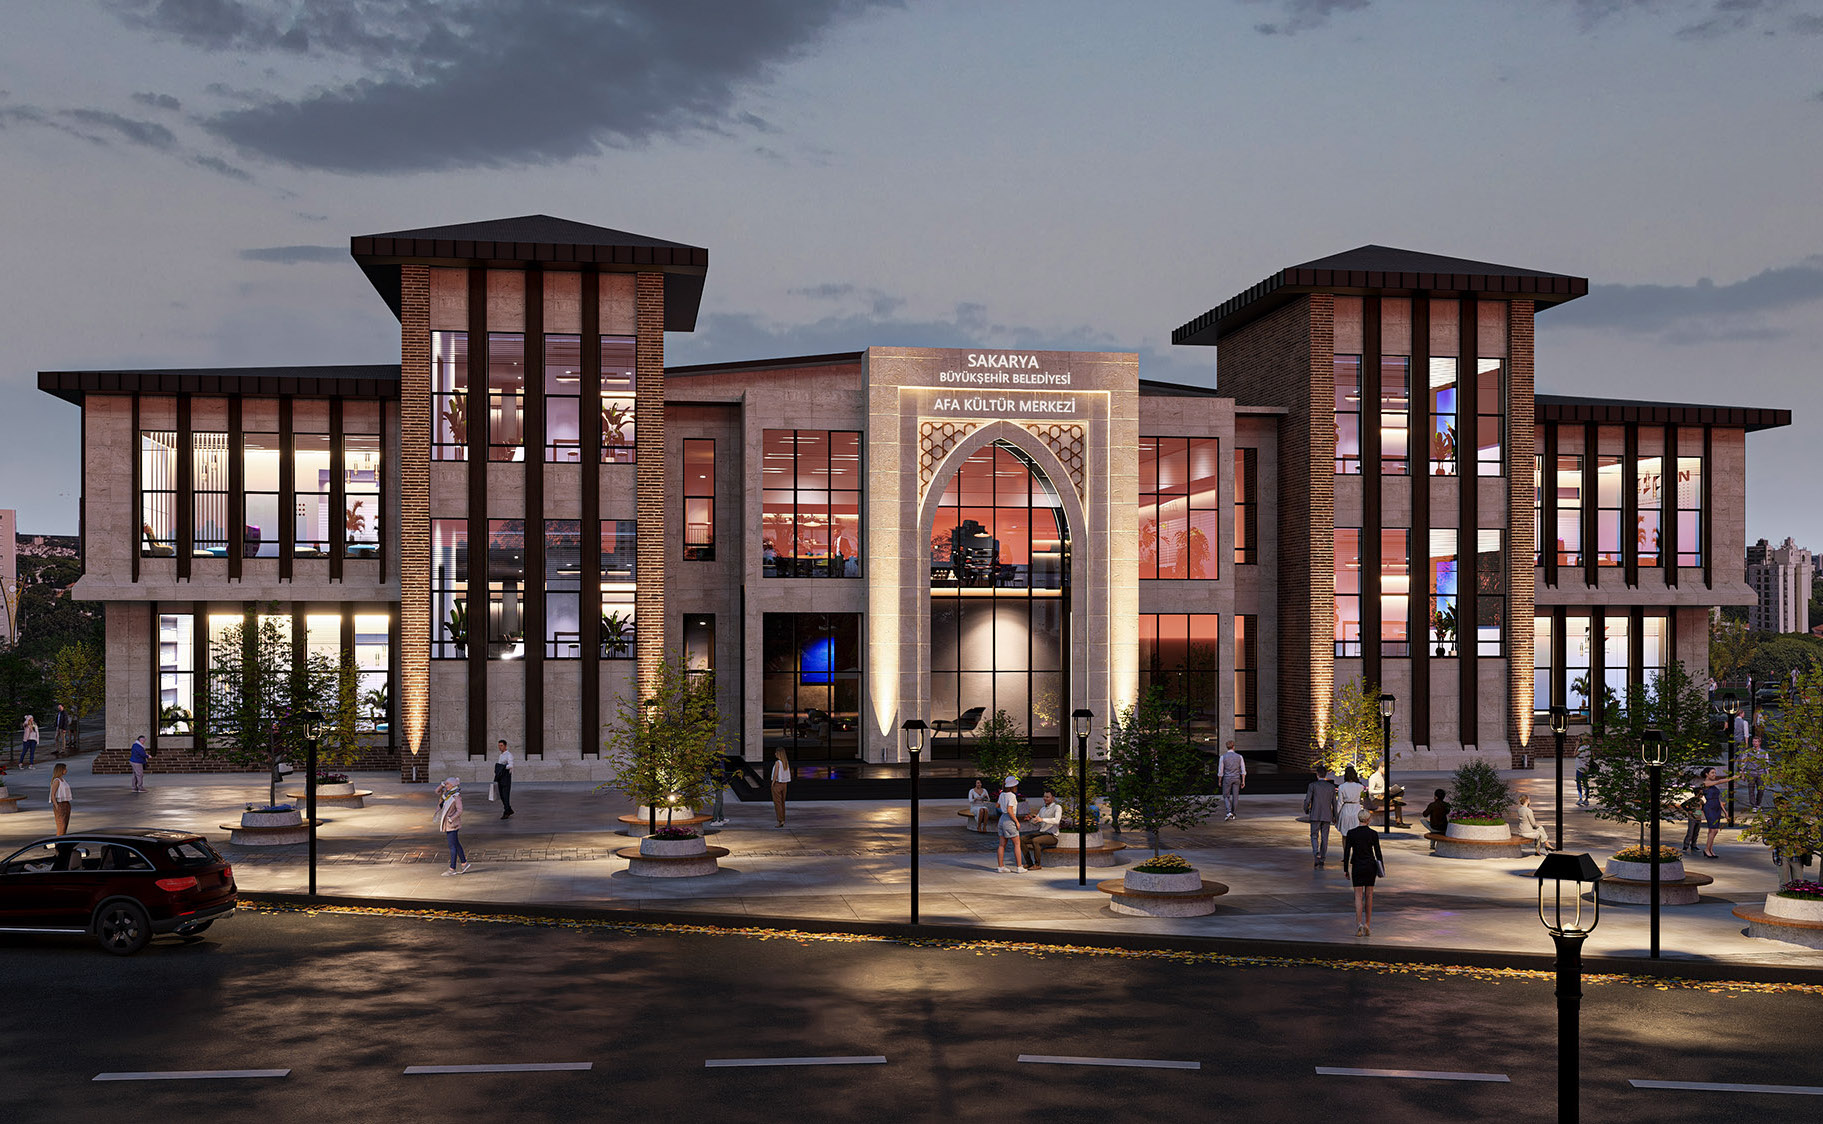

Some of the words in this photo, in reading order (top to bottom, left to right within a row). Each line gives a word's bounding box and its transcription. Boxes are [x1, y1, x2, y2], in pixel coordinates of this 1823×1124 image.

[968, 354, 1039, 369] SAKARYA
[940, 371, 1009, 384] BÜYÜKŞEHİR
[1013, 372, 1070, 384] BELEDİYESİ
[934, 399, 960, 411] AFA
[964, 397, 1015, 411] KÜLTÜR
[1019, 398, 1075, 413] MERKEZİ
